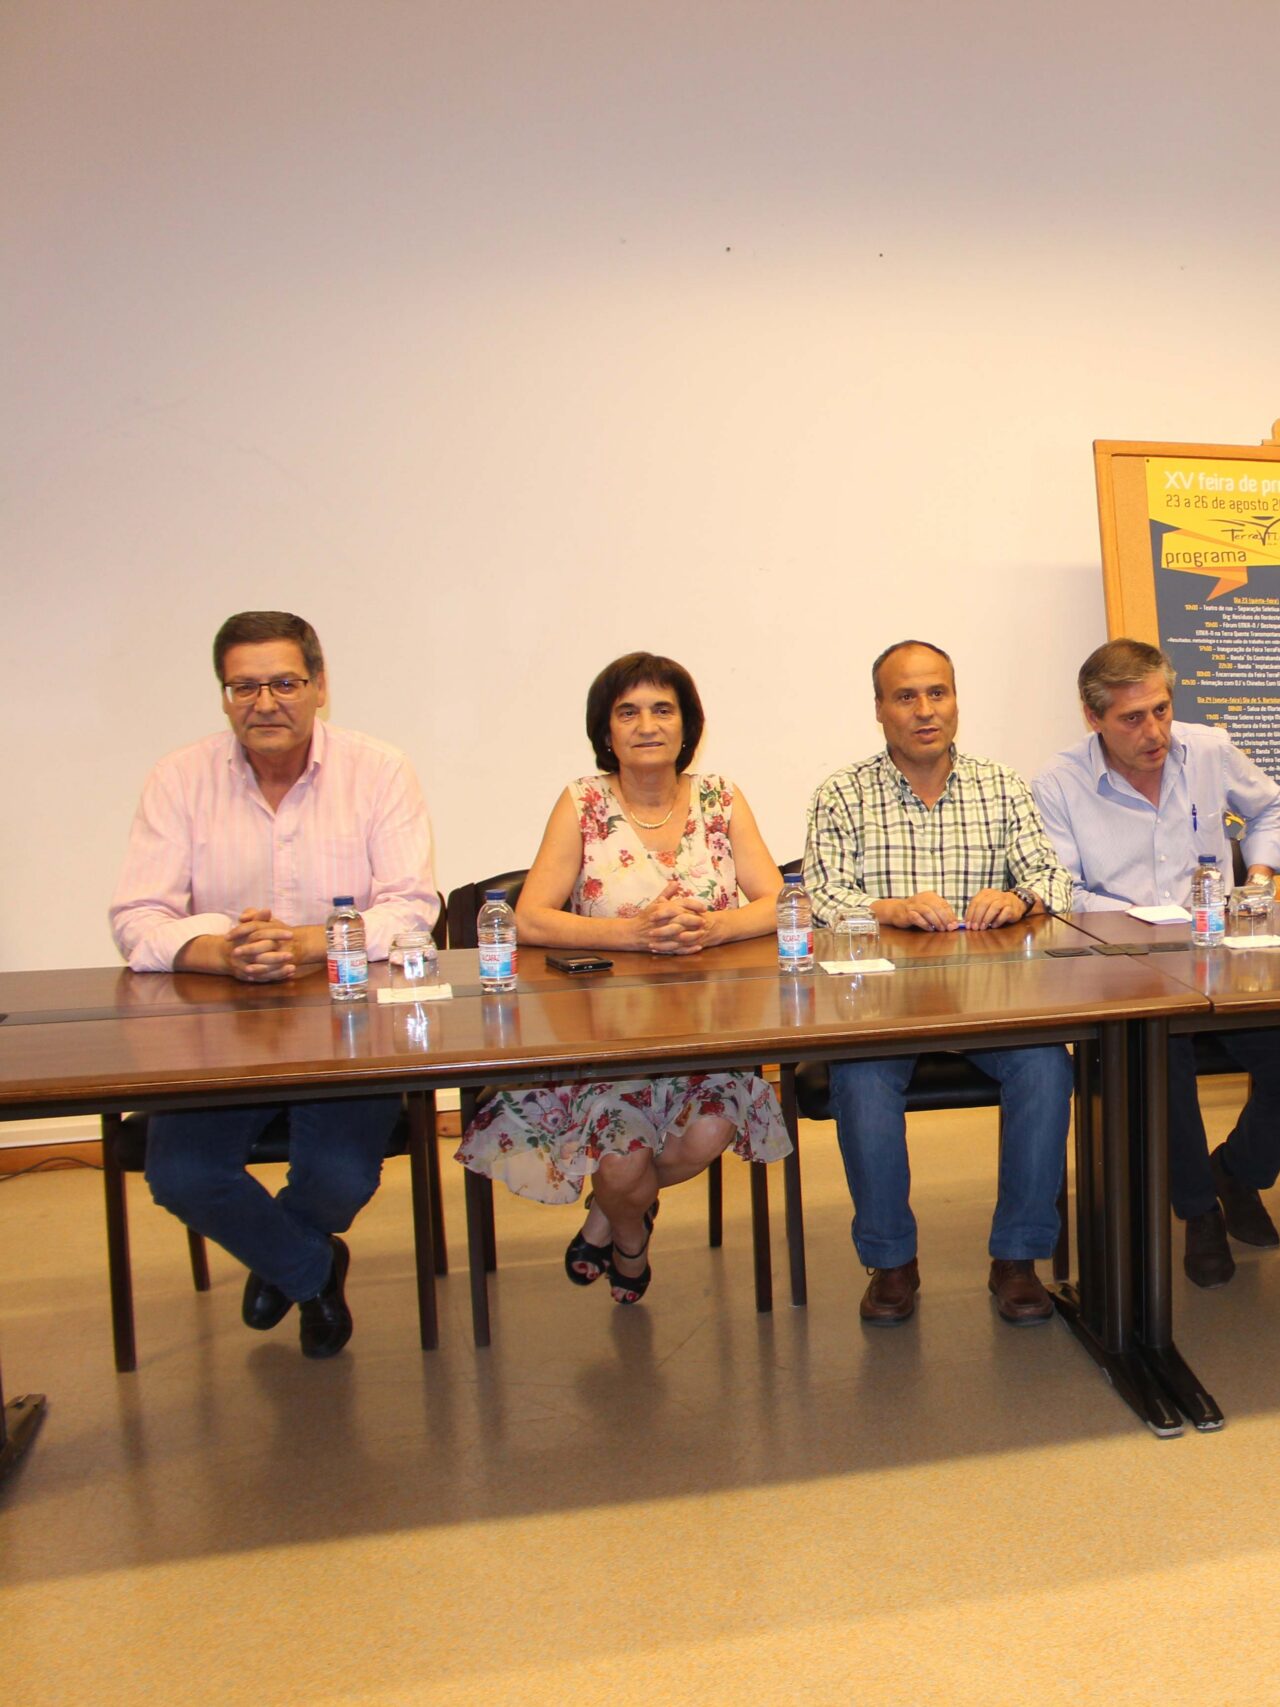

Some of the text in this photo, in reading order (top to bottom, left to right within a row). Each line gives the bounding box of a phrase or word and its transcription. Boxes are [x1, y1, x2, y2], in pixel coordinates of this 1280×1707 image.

[1164, 471, 1194, 490] XV
[1199, 473, 1234, 492] feira
[1240, 475, 1256, 492] de
[1166, 495, 1180, 508] 23
[1184, 498, 1191, 508] a
[1195, 496, 1208, 509] 26
[1212, 496, 1226, 510] de
[1229, 498, 1269, 513] agosto
[1165, 550, 1247, 567] programa
